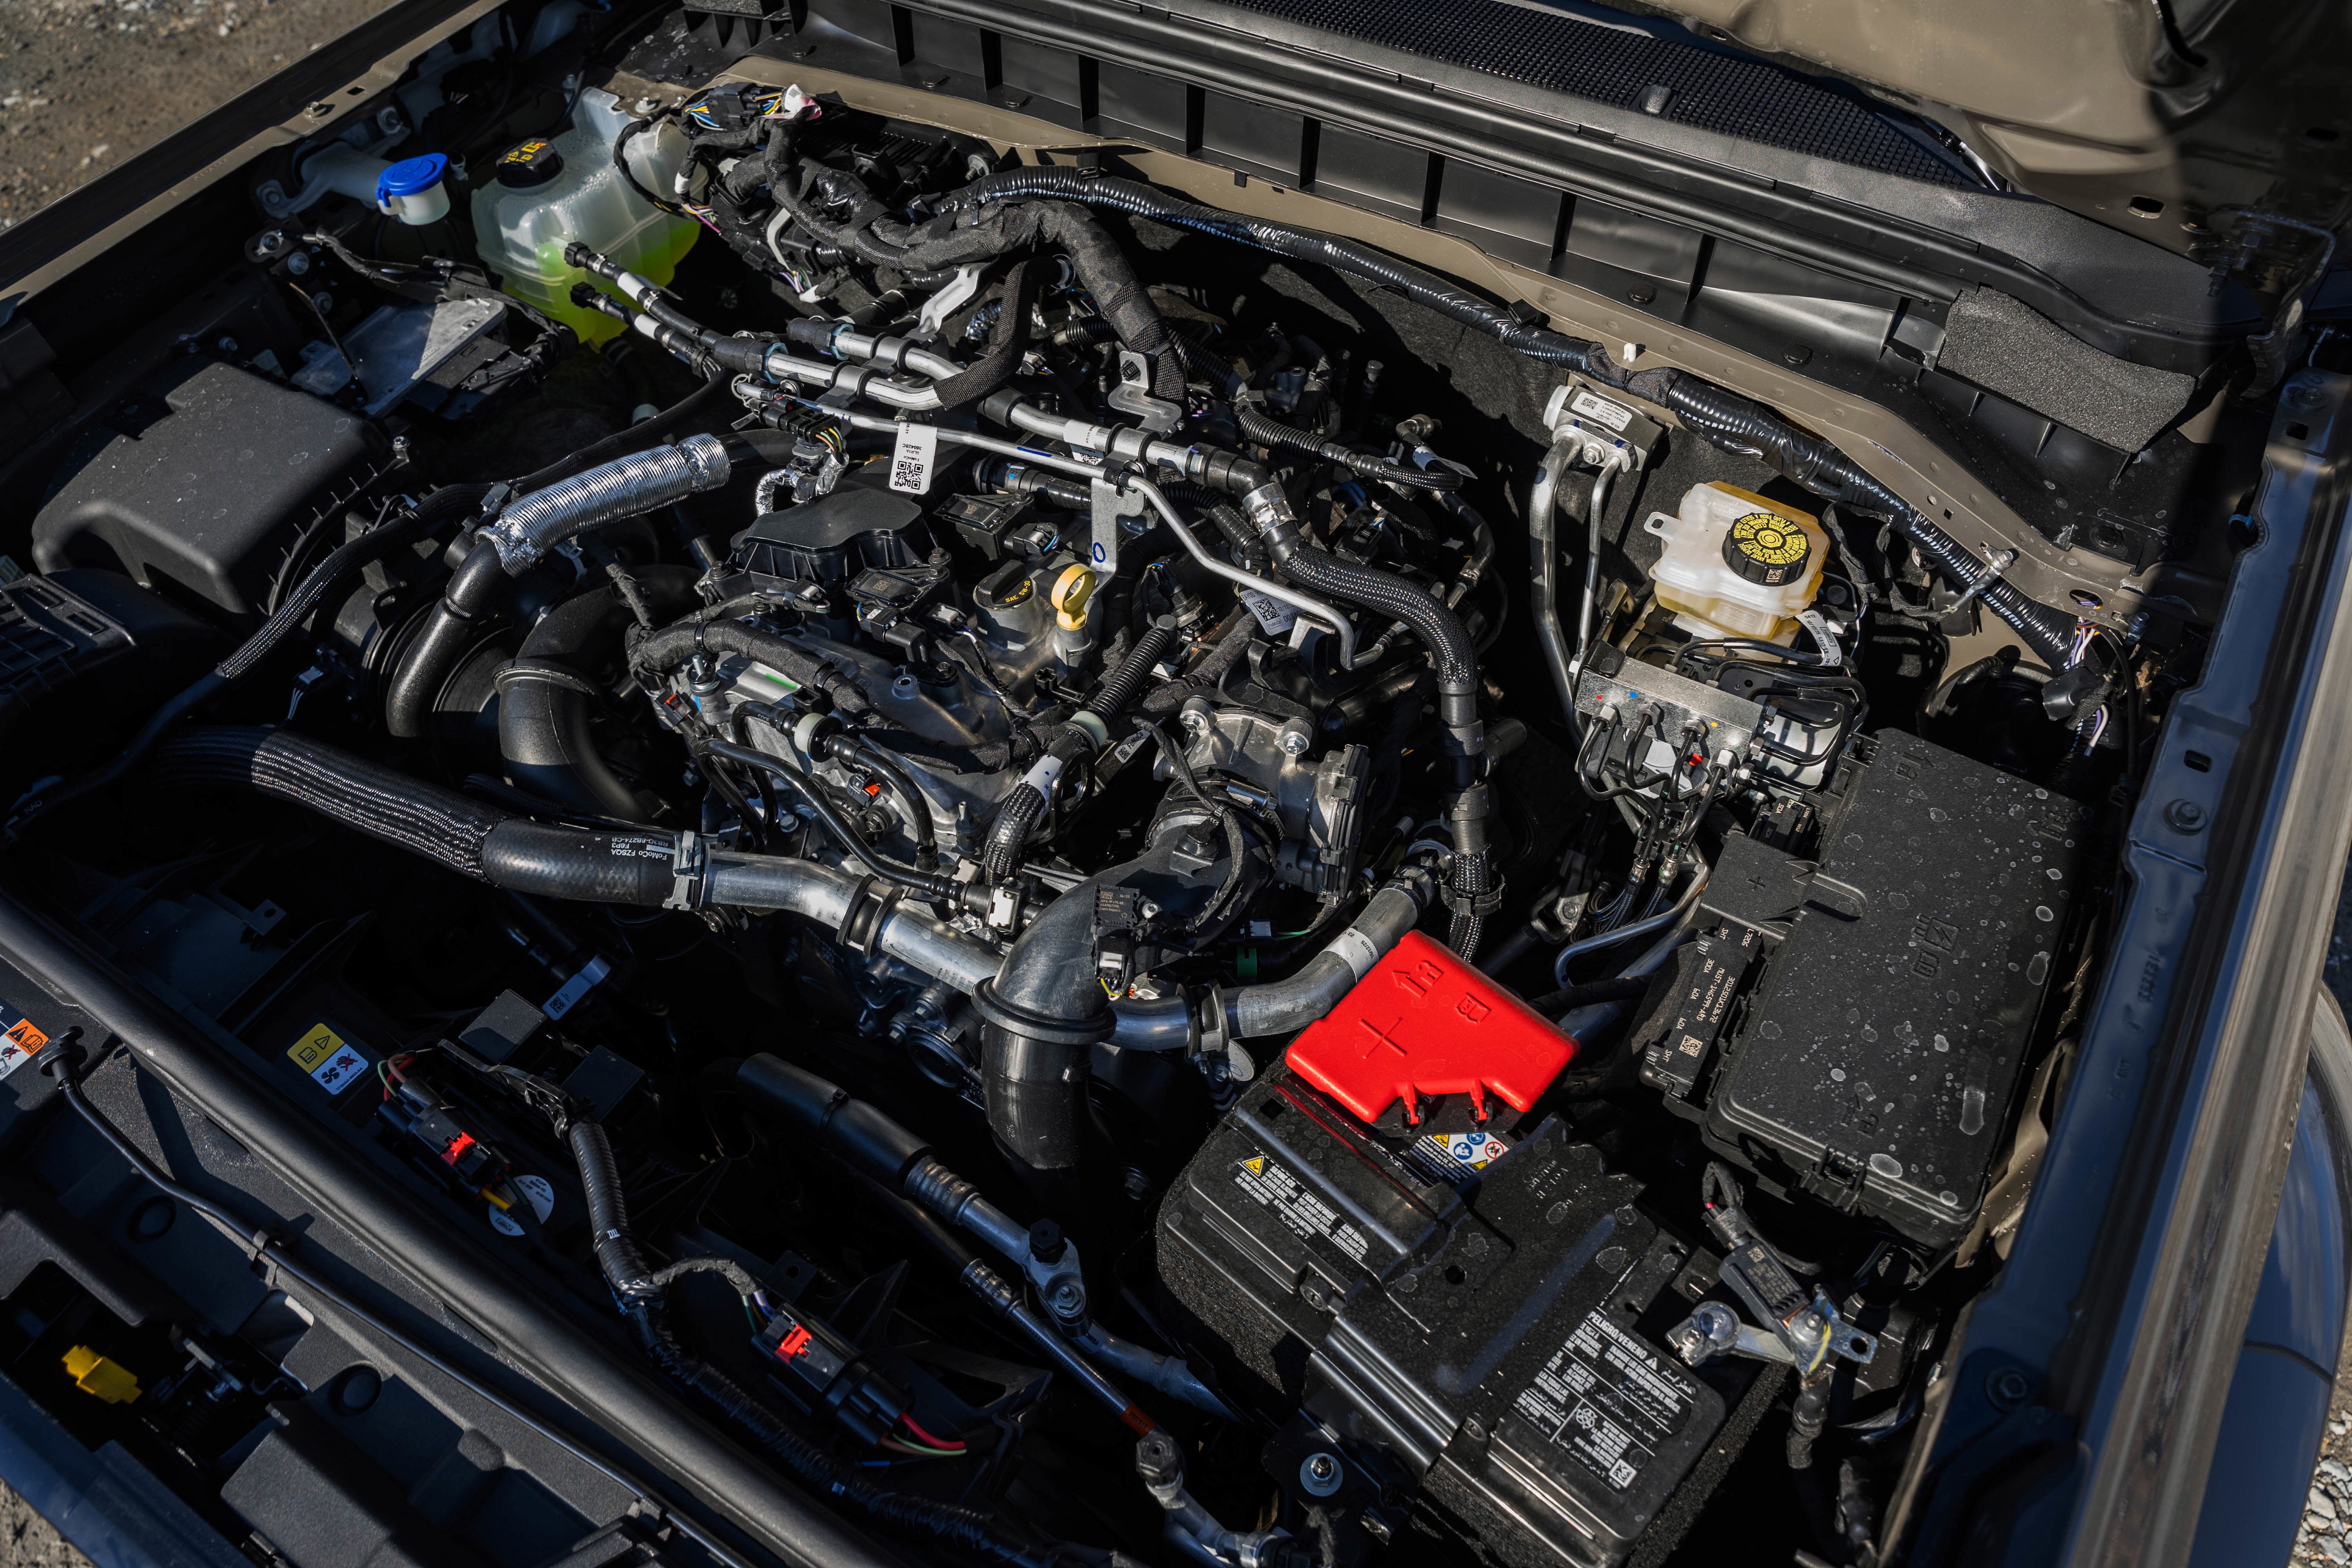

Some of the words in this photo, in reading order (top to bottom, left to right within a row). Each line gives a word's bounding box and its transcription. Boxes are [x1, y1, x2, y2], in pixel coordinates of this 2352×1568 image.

[1740, 514, 1754, 523] SEALED
[1769, 519, 1786, 528] BEFORE
[1747, 527, 1756, 539] FILLER
[1785, 526, 1793, 535] CAP
[1005, 593, 1019, 603] SAE
[1018, 580, 1031, 596] 5W-30
[1806, 620, 1821, 635] 10/12/25
[1823, 628, 1833, 644] FoMoCo
[1125, 730, 1144, 750] FoMoCo
[23, 798, 42, 815] RAD
[638, 851, 667, 860] FoMoCo
[1360, 940, 1374, 959] 16/12/25
[1702, 958, 1714, 974] 300A
[1690, 987, 1700, 1000] 60A
[1709, 975, 1735, 1023] 3012501K13672
[1675, 1017, 1686, 1030] 60A
[1662, 1049, 1672, 1062] SHT
[1417, 1139, 1434, 1152] Fabricado
[1421, 1135, 1431, 1144] Made
[1244, 1174, 1253, 1183] NOT
[1250, 1180, 1261, 1189] OPEN
[1265, 1178, 1278, 1191] SEVERE
[1265, 1171, 1274, 1179] CAN
[1270, 1175, 1283, 1186] CAUSE
[1279, 1183, 1298, 1199] BLINDNESS
[1269, 1165, 1288, 1182] SULFURIC
[1284, 1177, 1296, 1189] ACID
[1277, 1202, 1286, 1211] PAS
[1283, 1207, 1297, 1220] OUVRIR
[1336, 1228, 1349, 1240] PUEDE
[1345, 1236, 1360, 1249] CAUSAR
[1586, 1310, 1649, 1361] PELIGRO/VENENO
[1561, 1373, 1573, 1383] LOS
[1565, 1367, 1586, 1385] ALCANCE
[1582, 1381, 1592, 1390] DE
[1586, 1374, 1597, 1385] DEL
[1604, 1351, 1615, 1362] CON
[1650, 1386, 1660, 1396] CON
[1537, 1370, 1549, 1381] LEA
[1545, 1376, 1561, 1391] TODAS
[1558, 1386, 1569, 1397] LAS
[1602, 1421, 1620, 1436] BATTERY
[1618, 1433, 1630, 1444] MUST
[1607, 1432, 1627, 1449] RECYCLED
